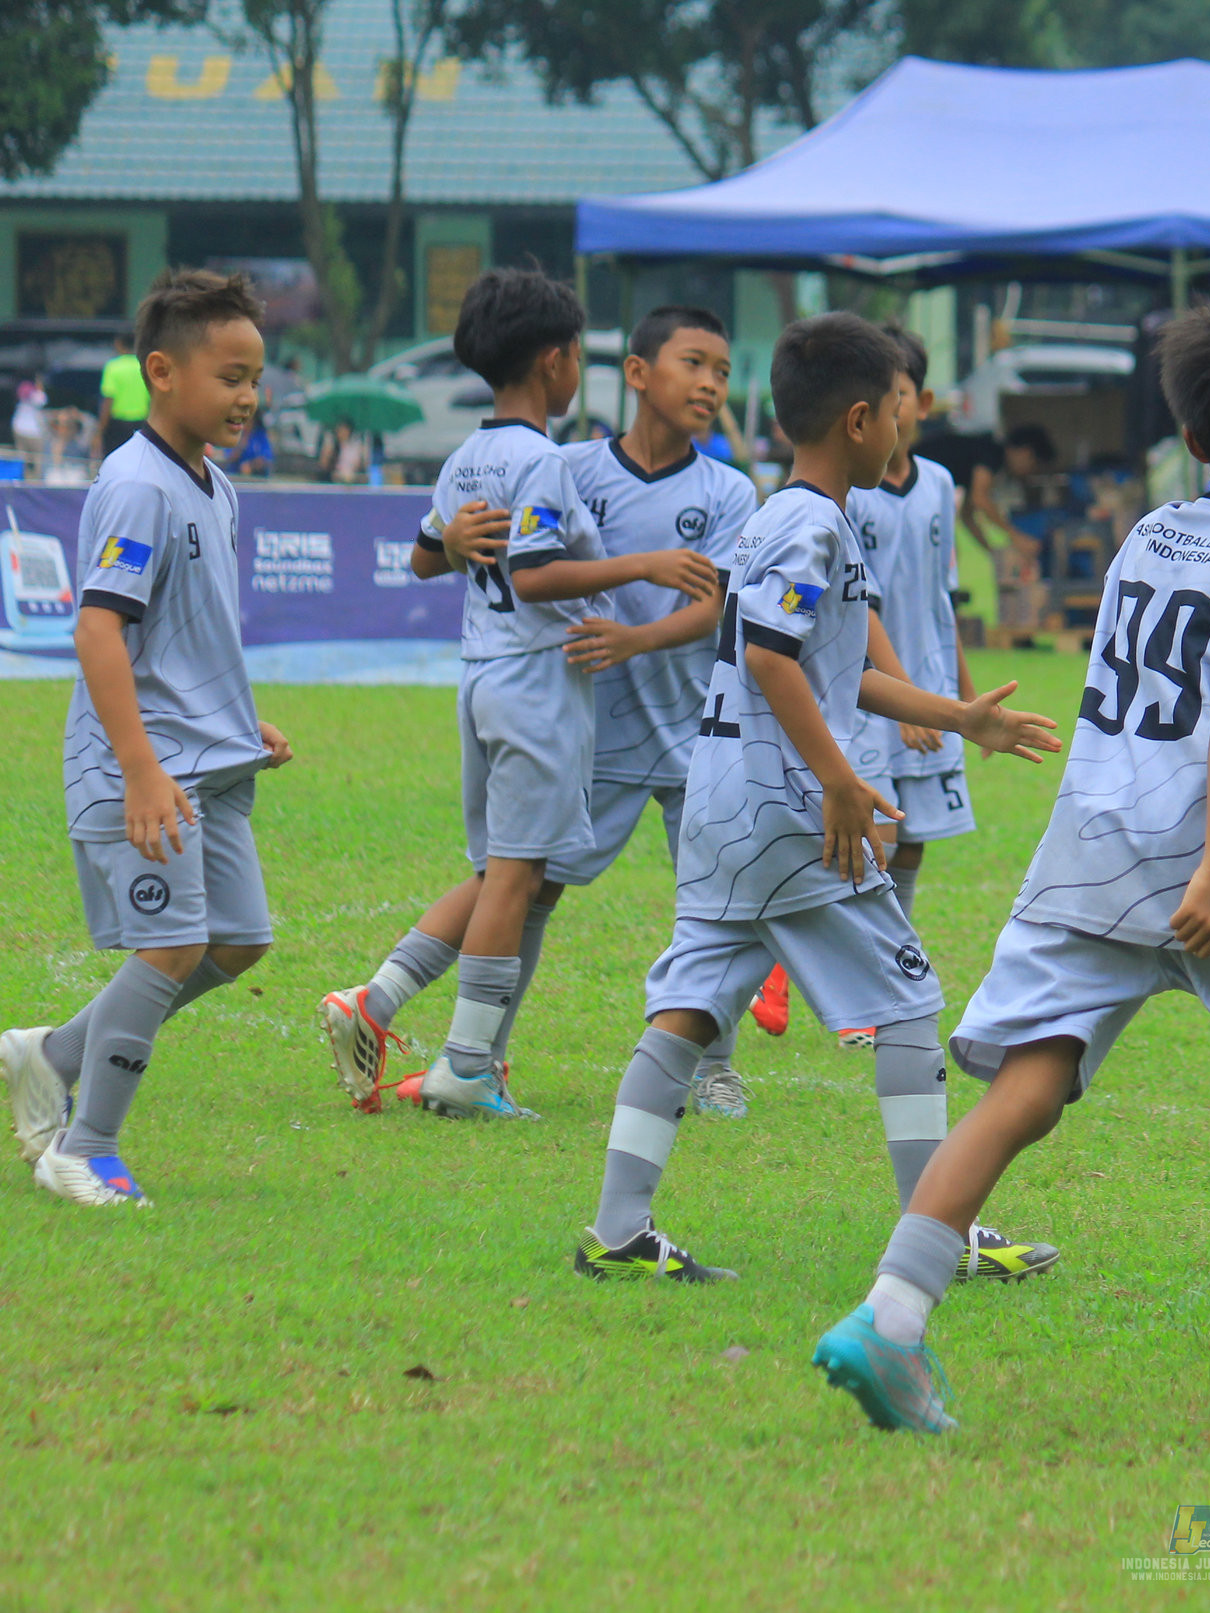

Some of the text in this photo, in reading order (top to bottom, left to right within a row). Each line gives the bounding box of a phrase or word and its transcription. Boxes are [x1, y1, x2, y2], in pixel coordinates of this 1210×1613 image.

[106, 54, 462, 99] UAN
[187, 522, 200, 560] 9
[941, 773, 963, 811] 5
